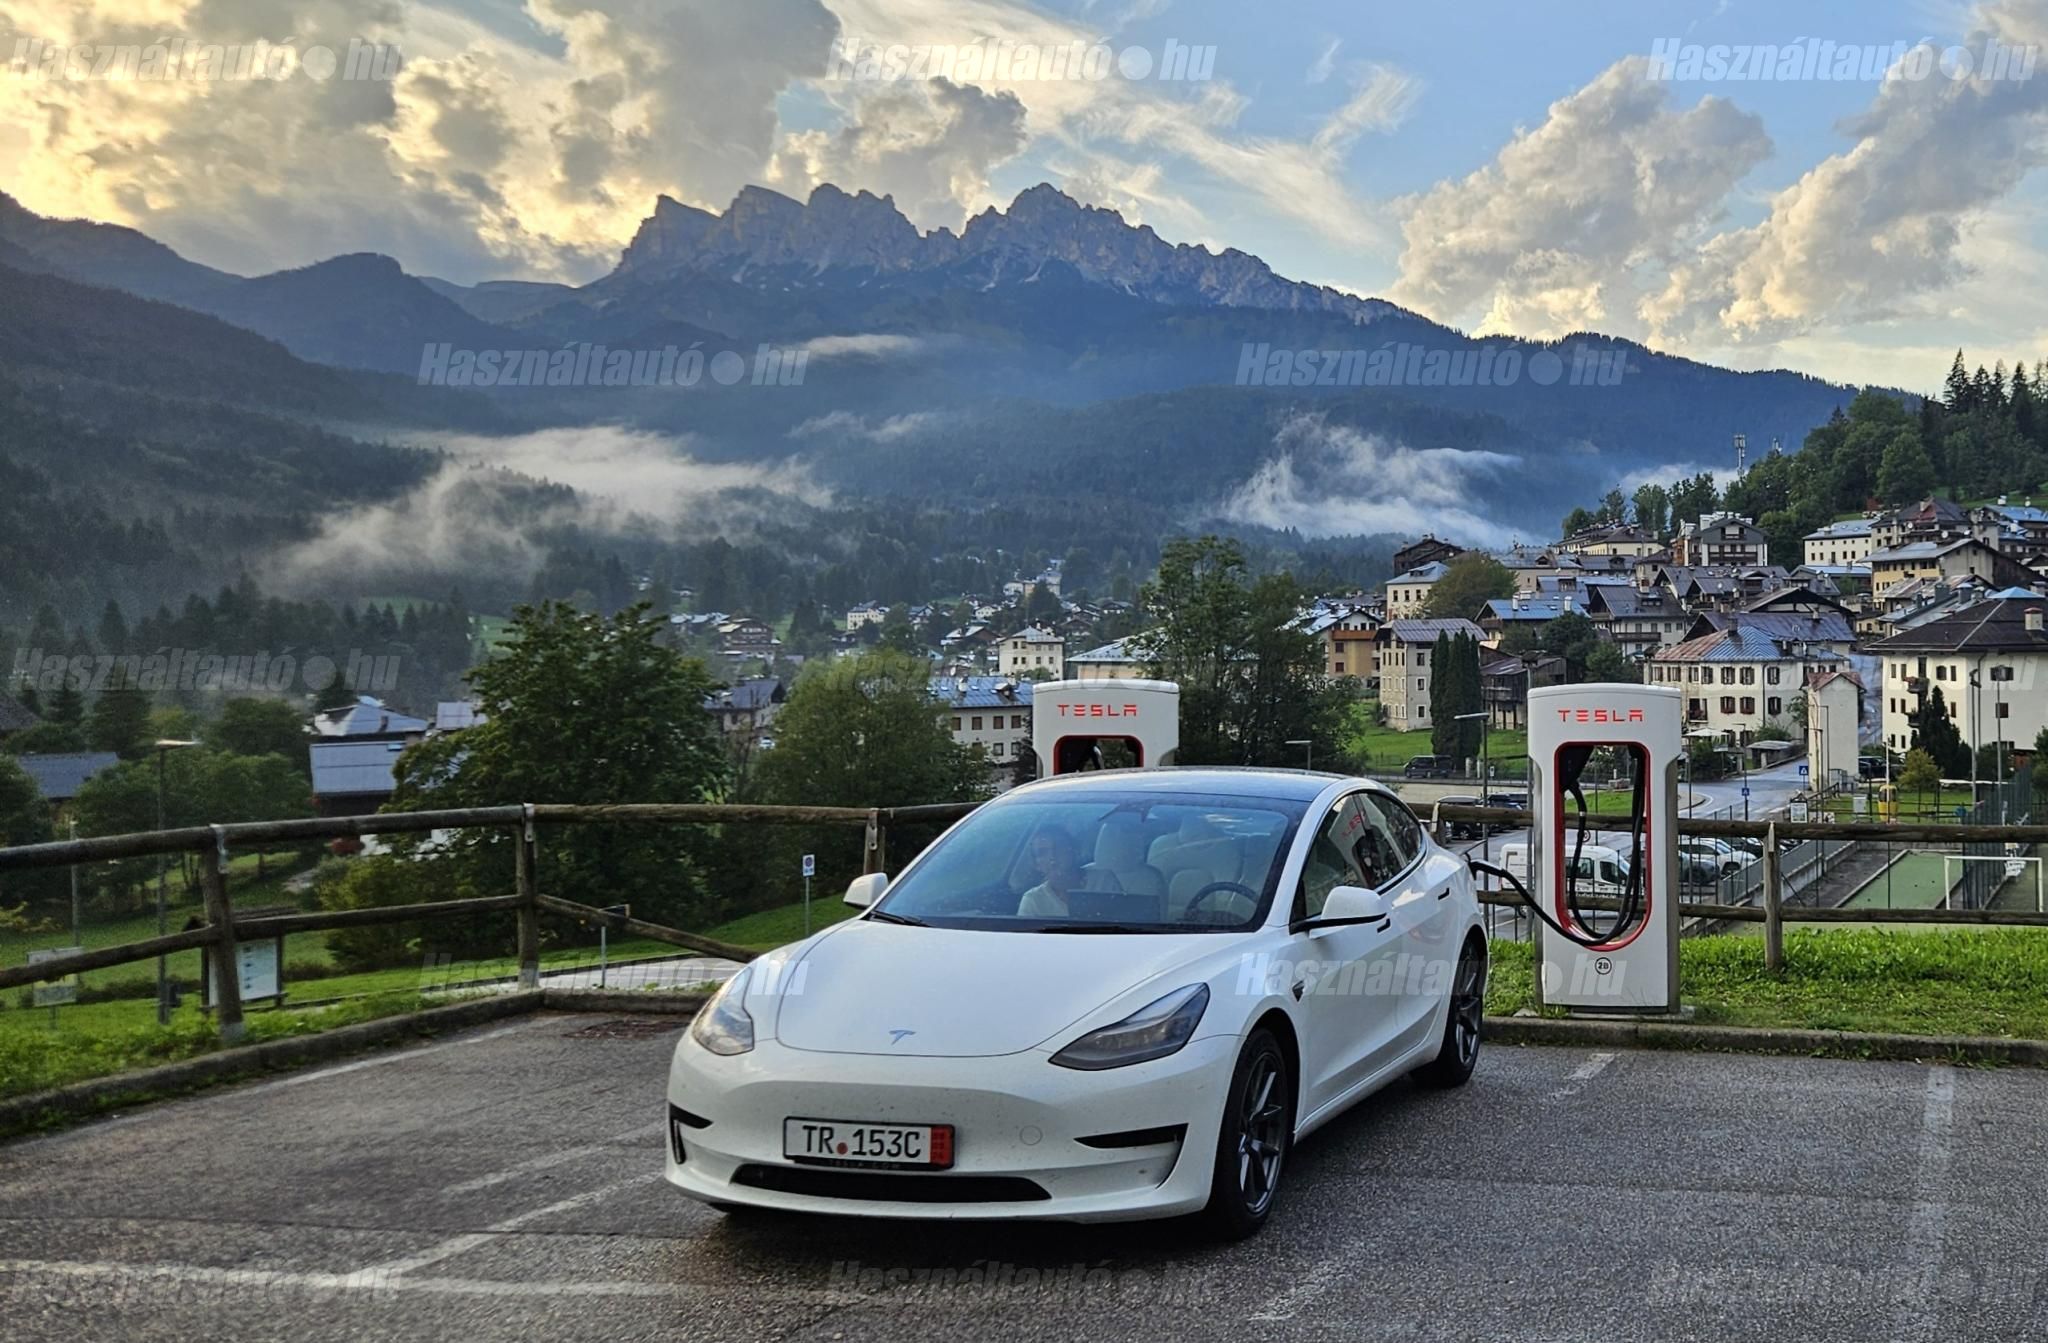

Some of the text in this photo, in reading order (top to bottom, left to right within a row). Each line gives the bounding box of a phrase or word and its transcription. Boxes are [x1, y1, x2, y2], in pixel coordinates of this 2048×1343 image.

[1057, 704, 1137, 717] TESLA
[1557, 709, 1644, 723] TESLA
[802, 1125, 835, 1154] TR
[852, 1128, 921, 1158] 153C
